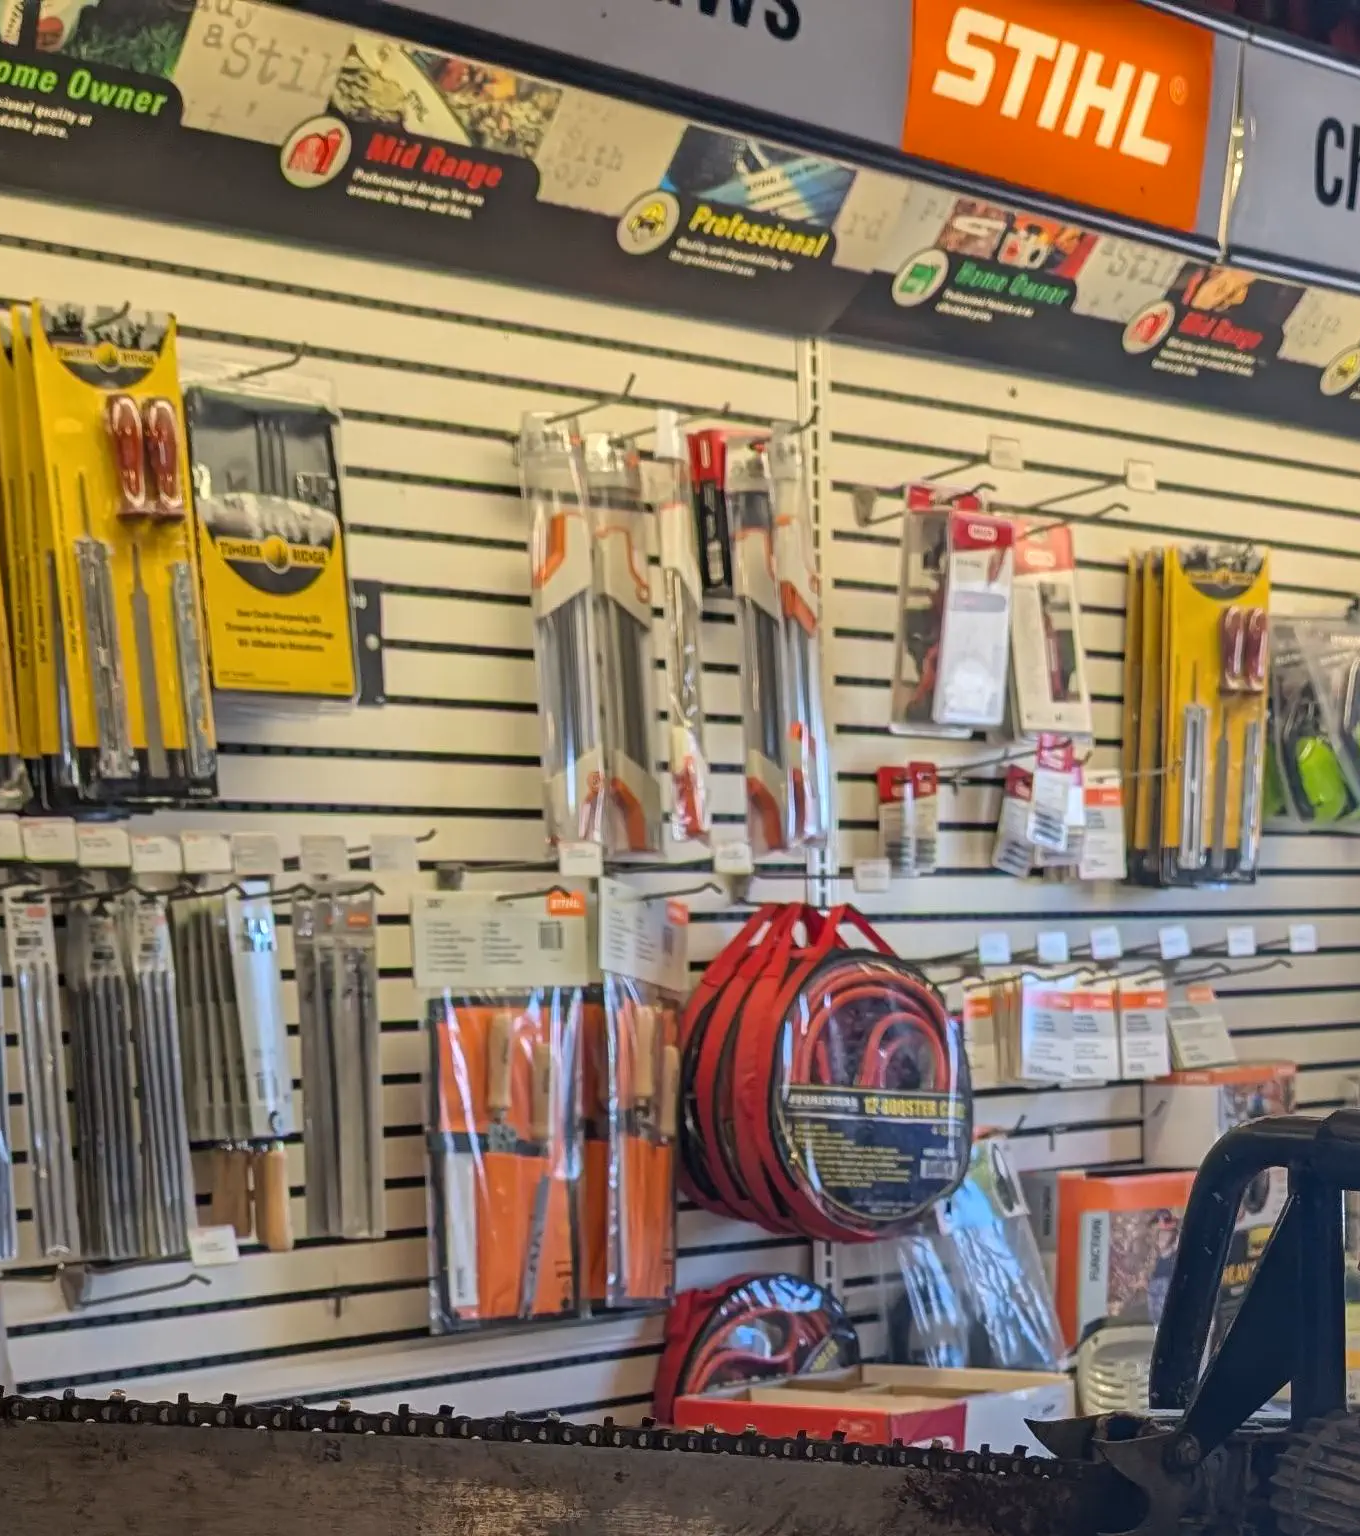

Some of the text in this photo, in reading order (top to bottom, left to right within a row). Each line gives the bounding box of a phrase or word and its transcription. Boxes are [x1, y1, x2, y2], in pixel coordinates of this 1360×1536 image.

[67, 68, 169, 116] Owner
[931, 6, 1172, 167] STIHL
[365, 132, 503, 190] Mid Range
[689, 204, 829, 259] Professional
[881, 1097, 937, 1117] BOOSTER
